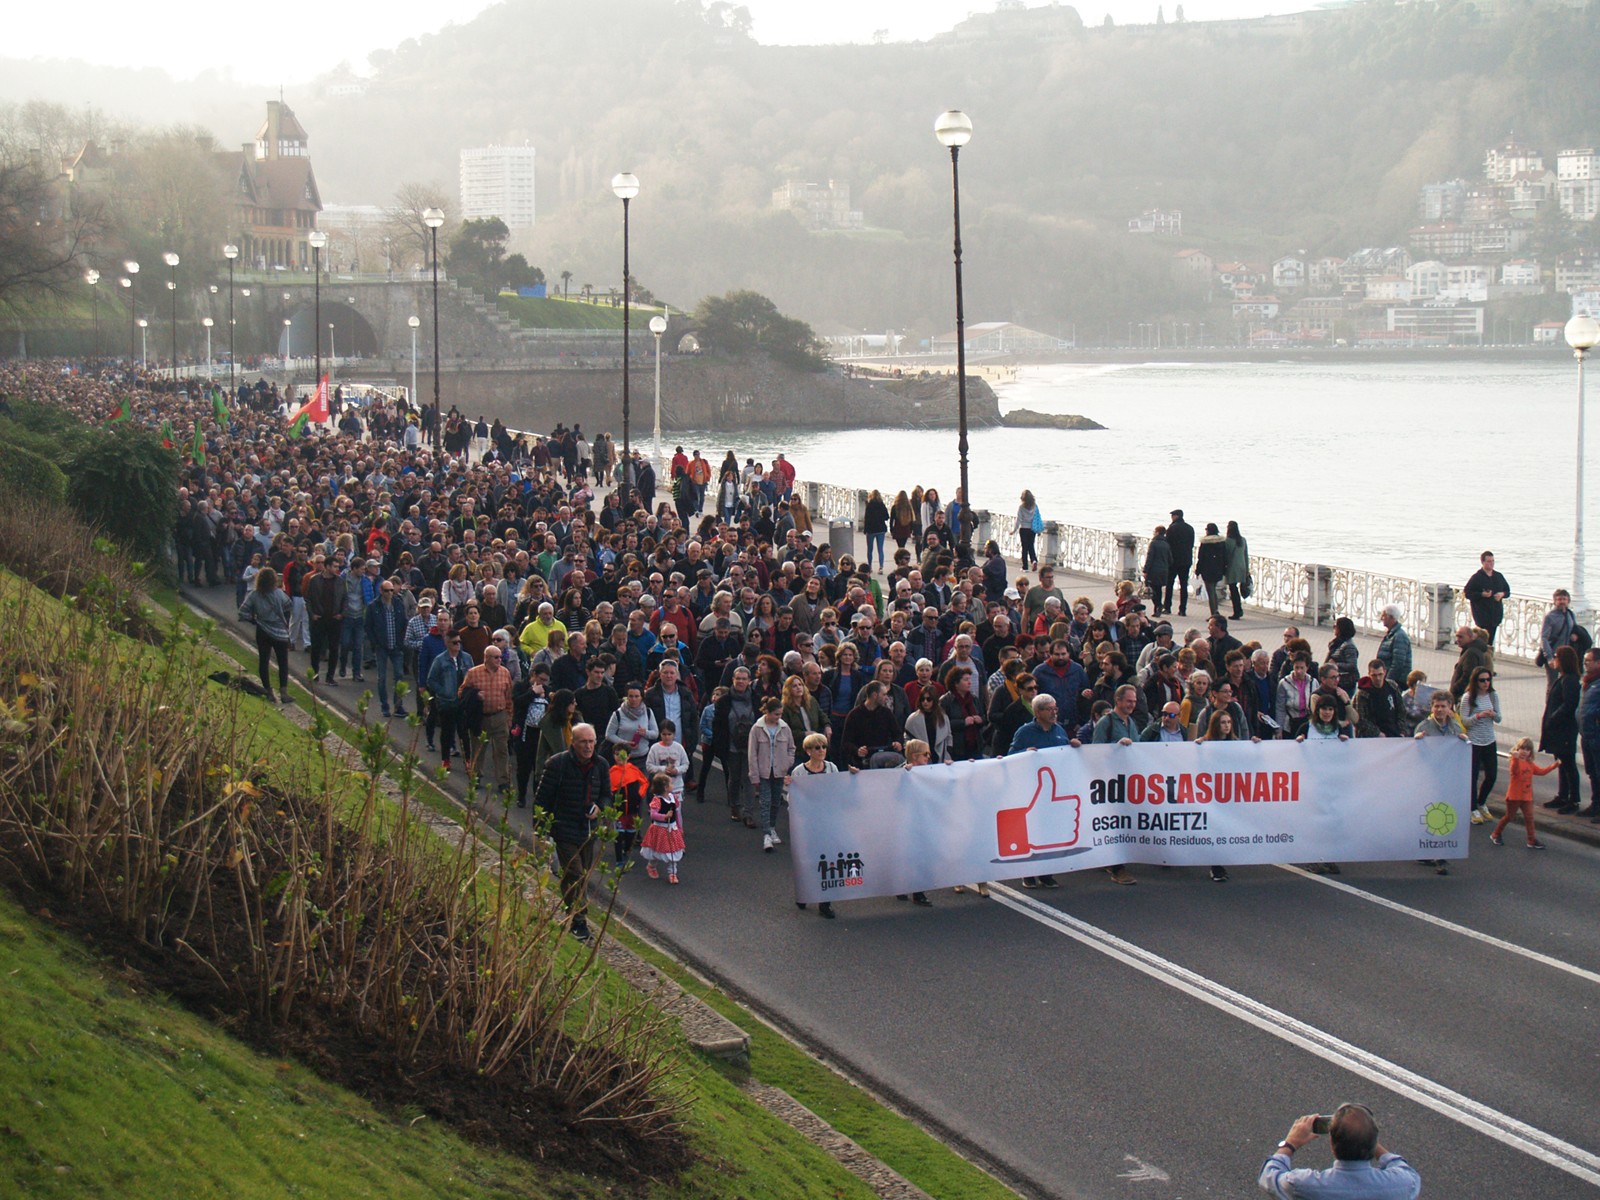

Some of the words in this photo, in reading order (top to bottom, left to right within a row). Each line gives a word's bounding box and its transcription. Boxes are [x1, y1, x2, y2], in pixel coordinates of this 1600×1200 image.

[1090, 771, 1299, 805] adOStASUNARI
[1092, 815, 1131, 832] esan
[1137, 812, 1208, 831] BAIETZ!
[1093, 836, 1102, 847] La
[1104, 833, 1137, 845] Gestión
[1139, 834, 1151, 845] de
[1153, 835, 1167, 846] los
[1169, 835, 1215, 847] Residuos,
[1216, 836, 1227, 845] es
[1229, 836, 1250, 845] cosa
[1252, 834, 1264, 844] de
[1265, 833, 1294, 843] tod@s
[1419, 839, 1458, 848] hitzartu
[821, 877, 863, 891] gurasos
